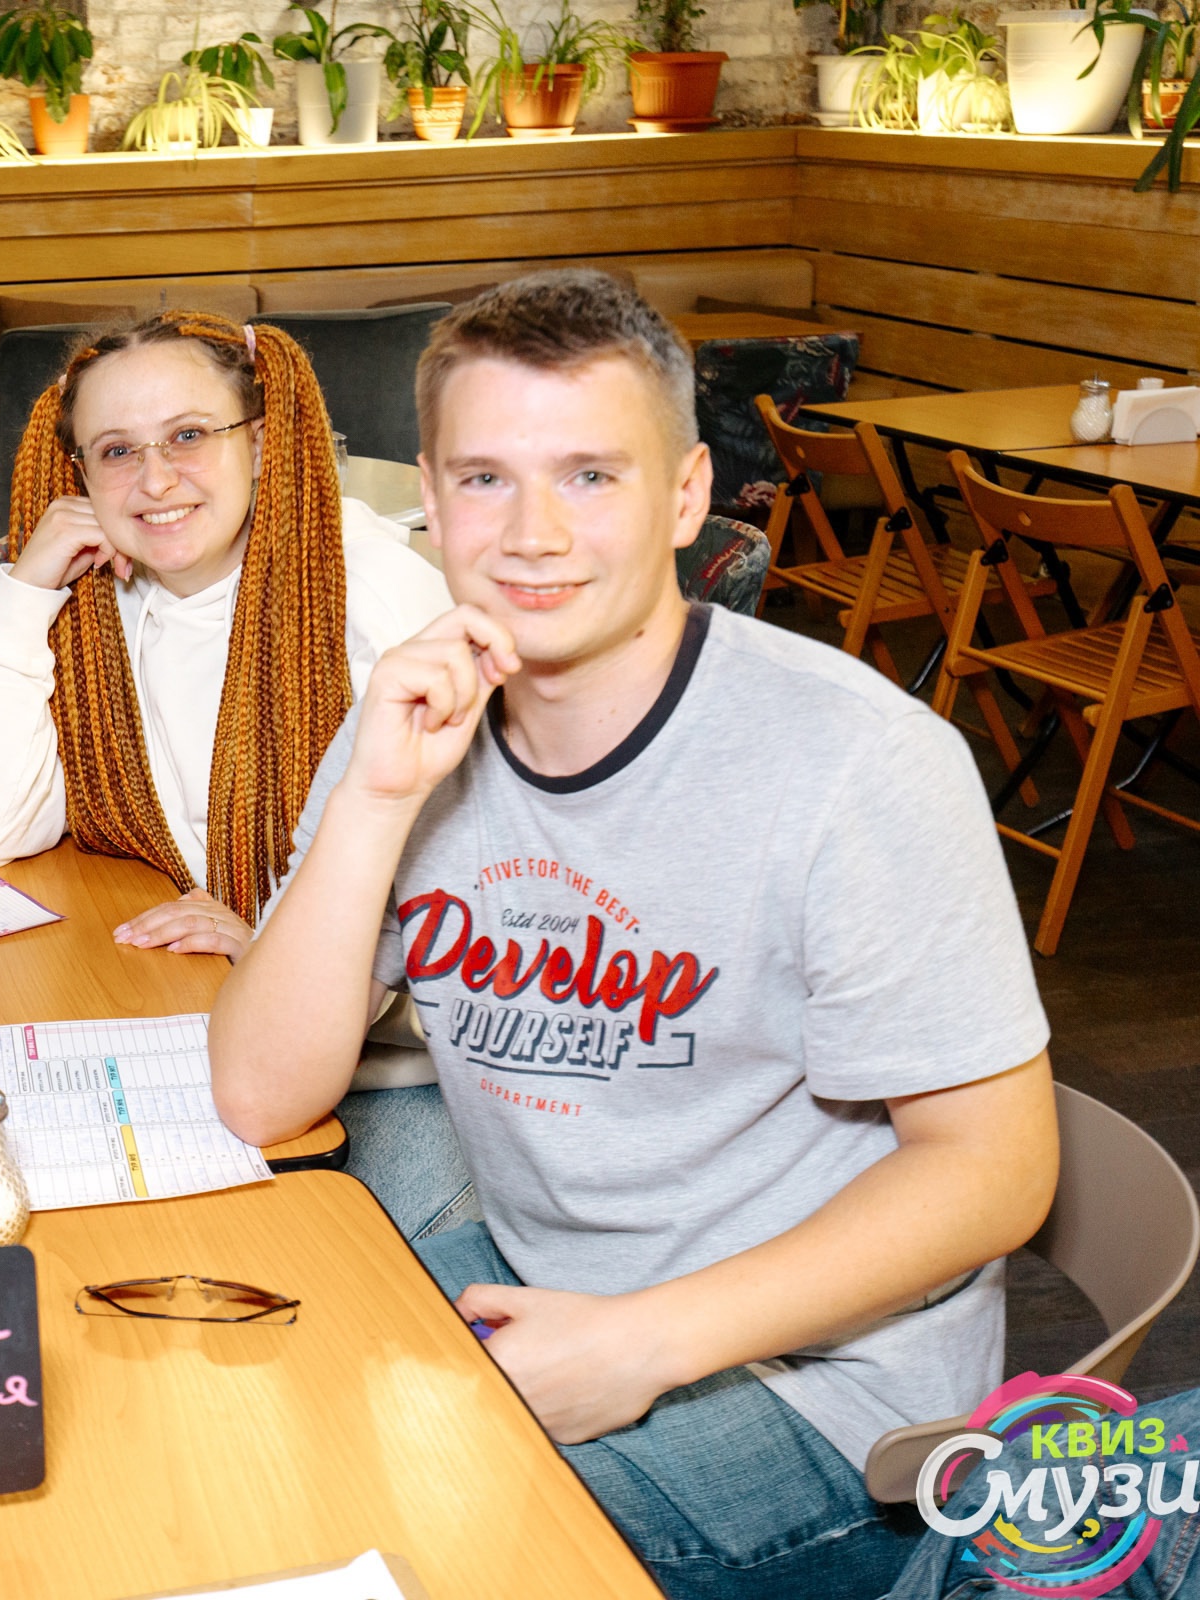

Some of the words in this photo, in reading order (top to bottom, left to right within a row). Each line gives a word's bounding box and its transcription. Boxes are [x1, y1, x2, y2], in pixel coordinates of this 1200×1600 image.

[501, 908, 537, 929] Estd
[537, 913, 581, 934] 2004
[528, 857, 559, 881] FOR
[565, 866, 594, 897] THE
[594, 888, 641, 931] BEST
[397, 888, 720, 1046] Develop
[449, 998, 635, 1070] YOURSELF
[481, 1078, 583, 1117] DEPARTMENT
